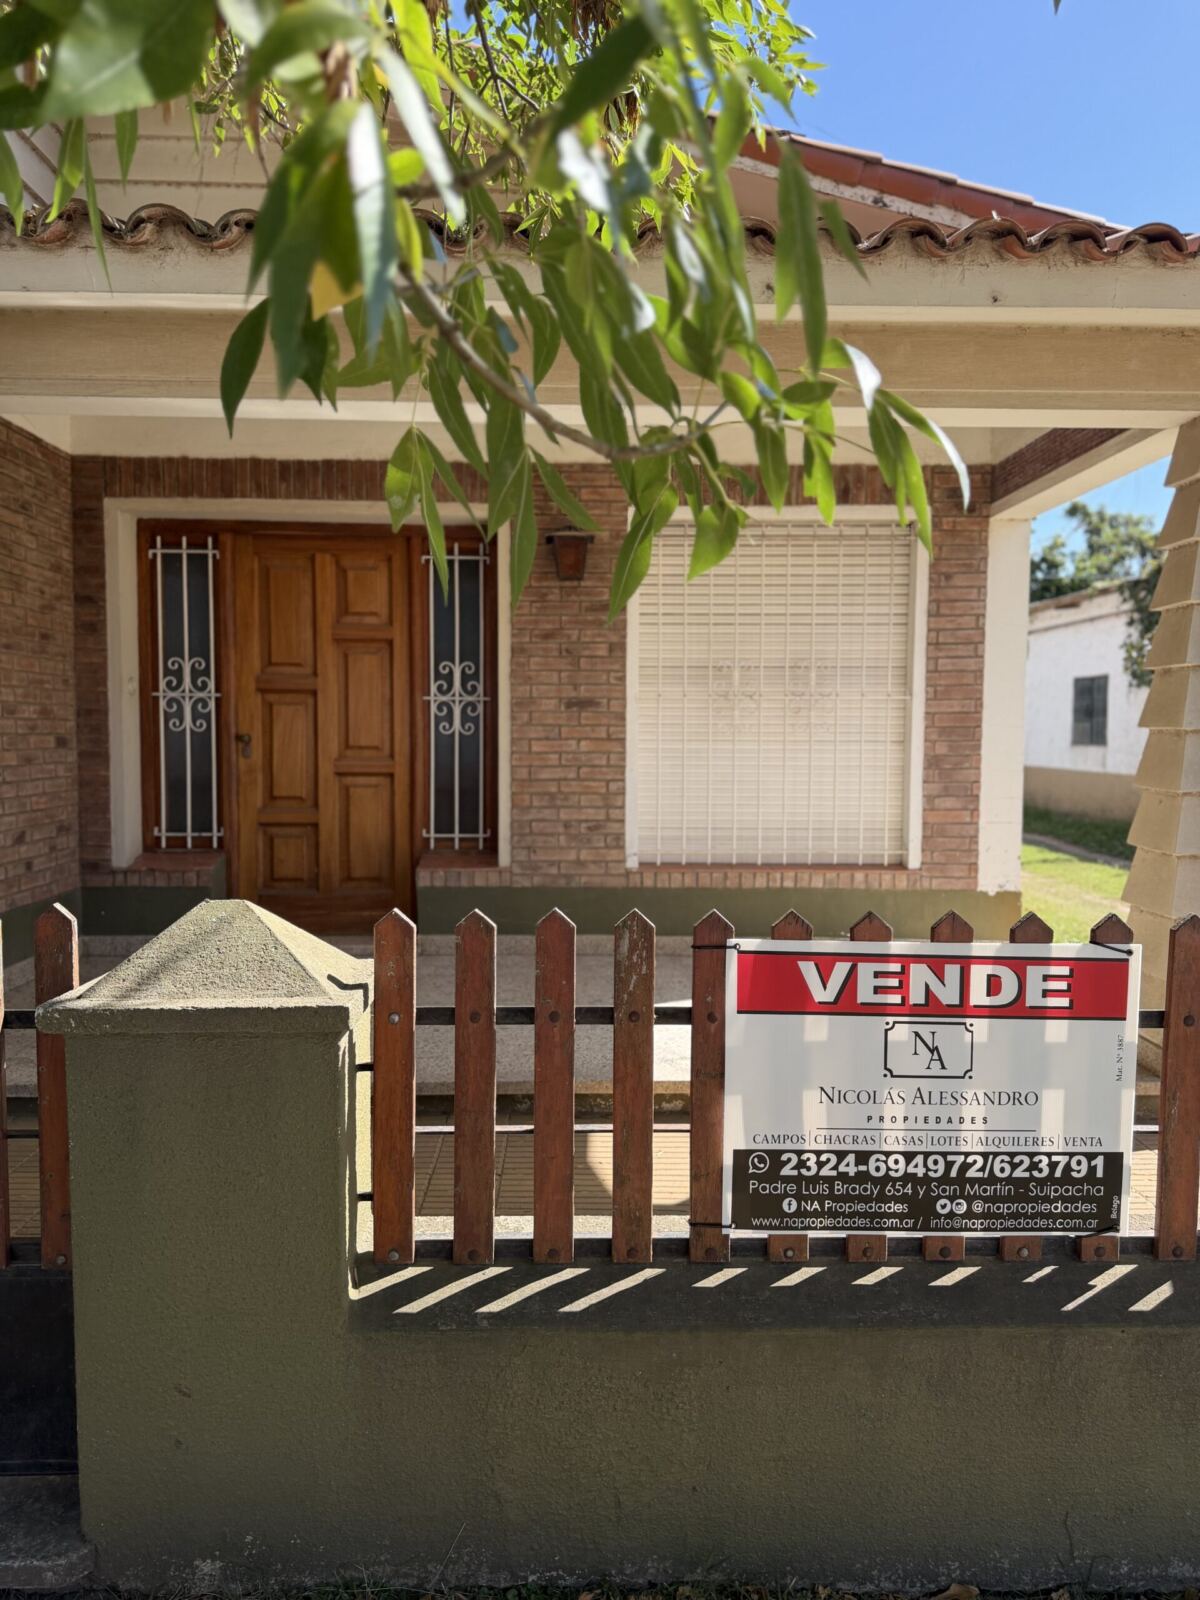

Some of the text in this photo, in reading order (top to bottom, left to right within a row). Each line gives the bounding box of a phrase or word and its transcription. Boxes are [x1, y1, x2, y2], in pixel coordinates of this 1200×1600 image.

[797, 961, 1073, 1010] VENDE
[912, 1031, 948, 1070] NA
[911, 1086, 1039, 1107] ALESSANDRO
[867, 1115, 989, 1125] PROPIEDADES
[752, 1133, 1103, 1149] CAMPOS CHACRAS CASAS LOTES ALQUILERES VENTA
[779, 1152, 1105, 1179] 2324-694972/623791
[749, 1180, 797, 1195] Padre
[802, 1181, 829, 1195] Luis
[834, 1181, 881, 1199] Brady
[885, 1182, 913, 1196] 654
[917, 1185, 927, 1199] y
[930, 1183, 960, 1196] San
[1028, 1182, 1105, 1199] Suipacha
[801, 1200, 909, 1214] NA Propiedades
[971, 1200, 1097, 1215] @napropiedades
[751, 1216, 914, 1230] www.napropiedades.com.ar
[930, 1217, 1099, 1230] info@napropiedades.com.ar
